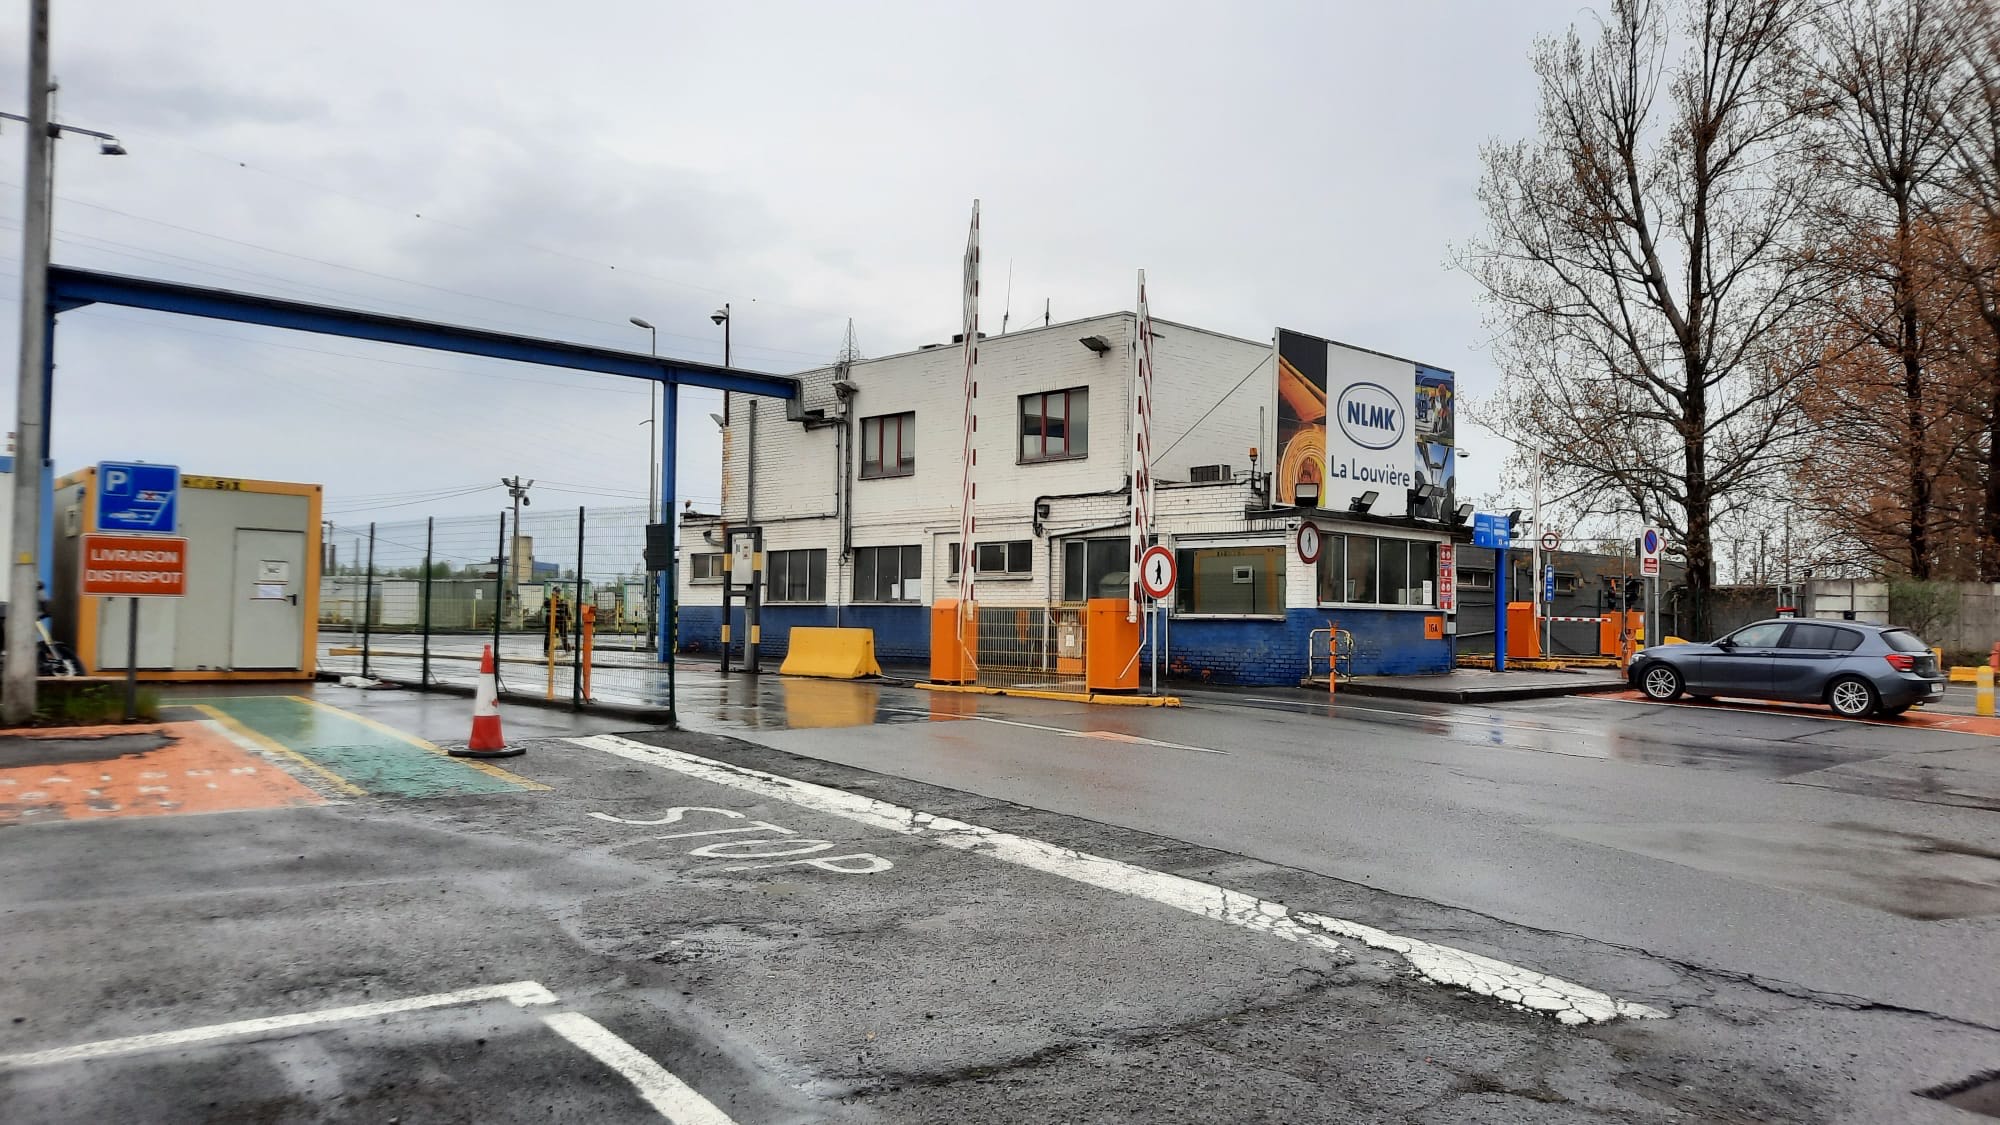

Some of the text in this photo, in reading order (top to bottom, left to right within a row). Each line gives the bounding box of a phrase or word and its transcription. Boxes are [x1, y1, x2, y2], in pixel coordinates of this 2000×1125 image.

[1347, 400, 1396, 432] NLMK
[106, 470, 128, 492] P
[1331, 454, 1410, 487] La Louvière
[91, 549, 179, 563] LIVRAISON
[87, 569, 183, 584] DISTRISPOT
[586, 806, 895, 874] STOP
